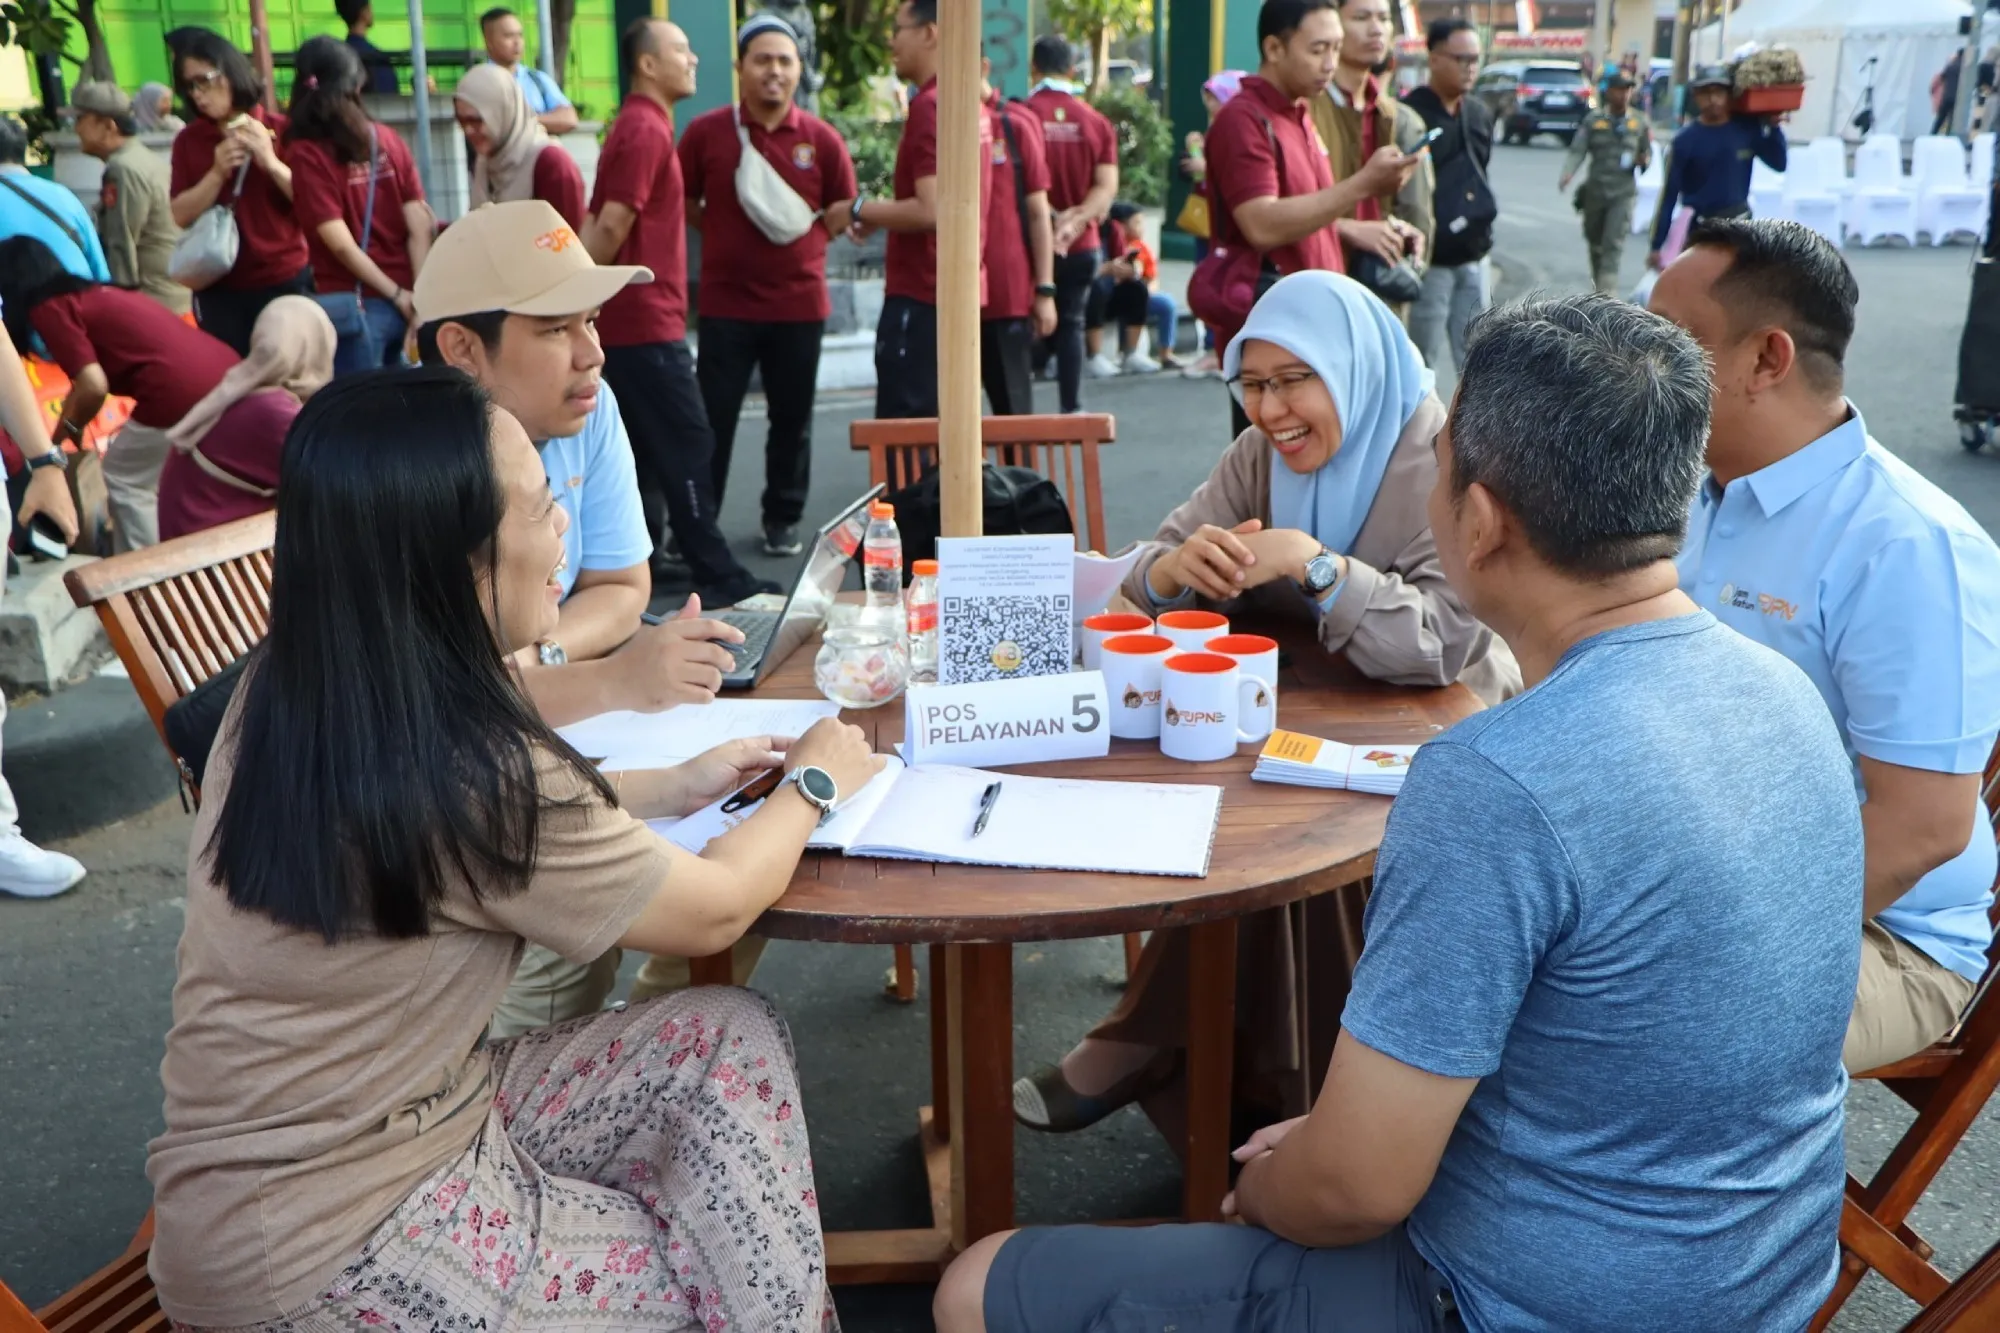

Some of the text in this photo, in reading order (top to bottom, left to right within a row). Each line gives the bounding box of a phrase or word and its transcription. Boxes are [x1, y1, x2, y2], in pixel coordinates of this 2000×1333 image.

[1732, 599, 1754, 611] datun
[927, 703, 977, 724] POS
[929, 693, 1100, 745] PELAYANAN 5
